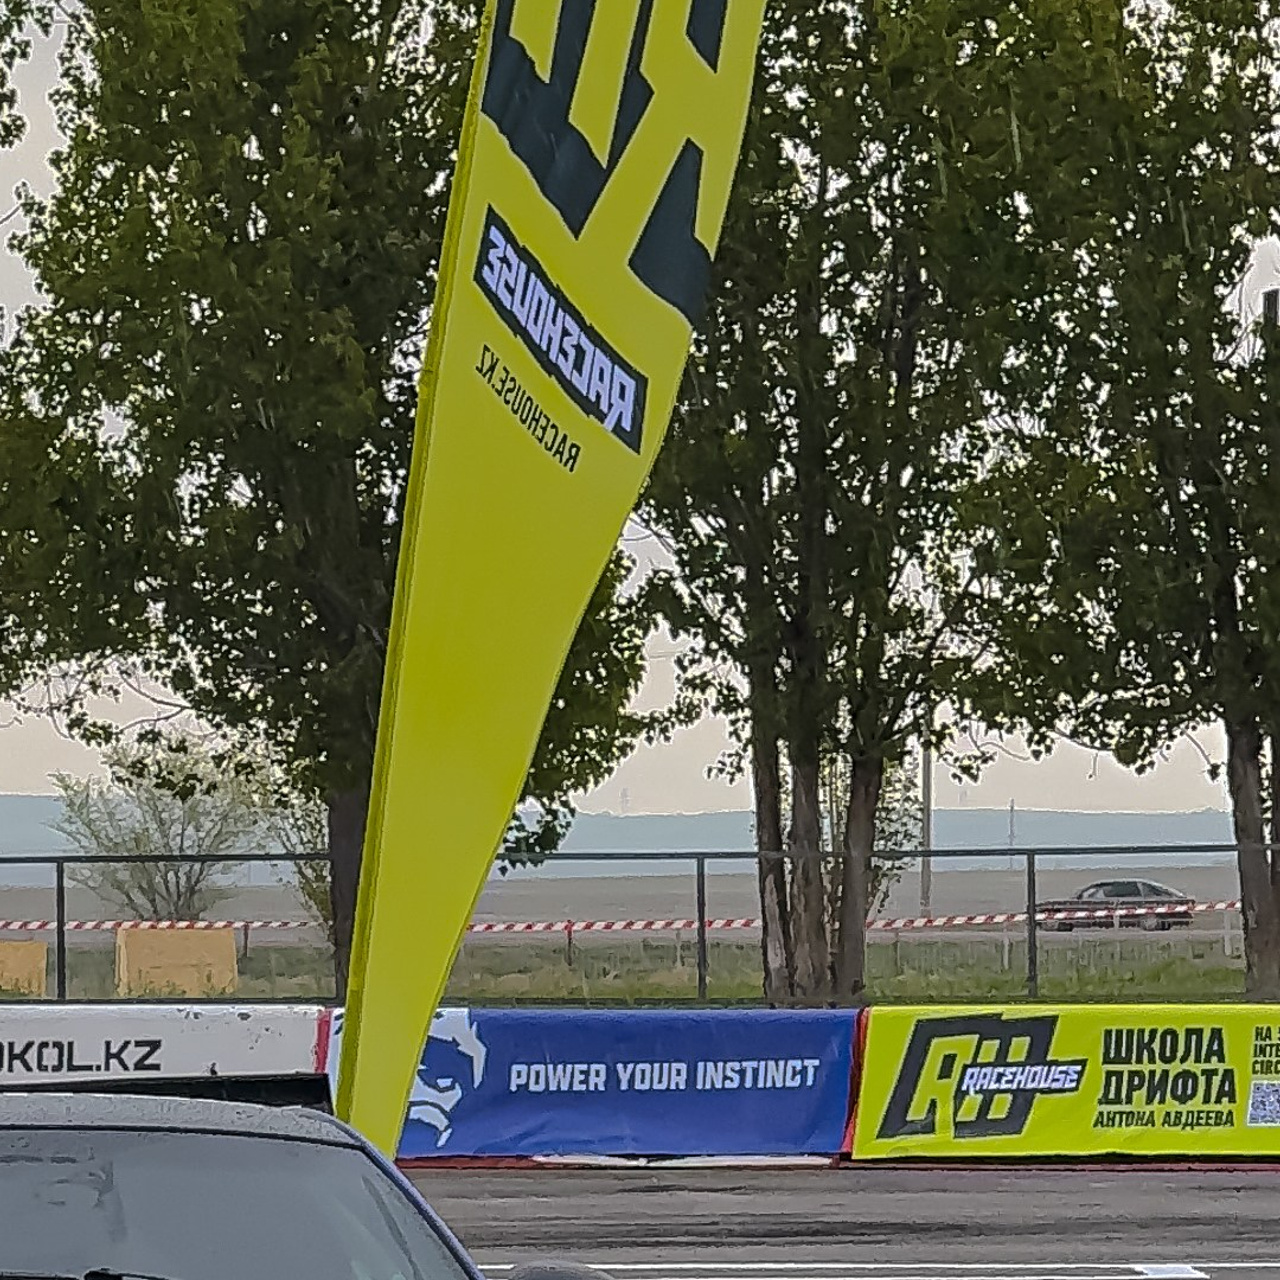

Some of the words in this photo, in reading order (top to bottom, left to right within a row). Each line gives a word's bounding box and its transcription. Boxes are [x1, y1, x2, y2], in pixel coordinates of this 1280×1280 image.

[1102, 1027, 1225, 1065] ШКОЛА
[509, 1063, 607, 1092] POWER
[616, 1061, 688, 1091] YOUR
[695, 1058, 820, 1090] INSTINCT
[961, 1065, 1082, 1095] RACEHOUSE
[1097, 1068, 1237, 1105] ДРИФТА
[1093, 1110, 1156, 1129] АНТОНА
[1161, 1110, 1235, 1130] АВДЕЕВА
